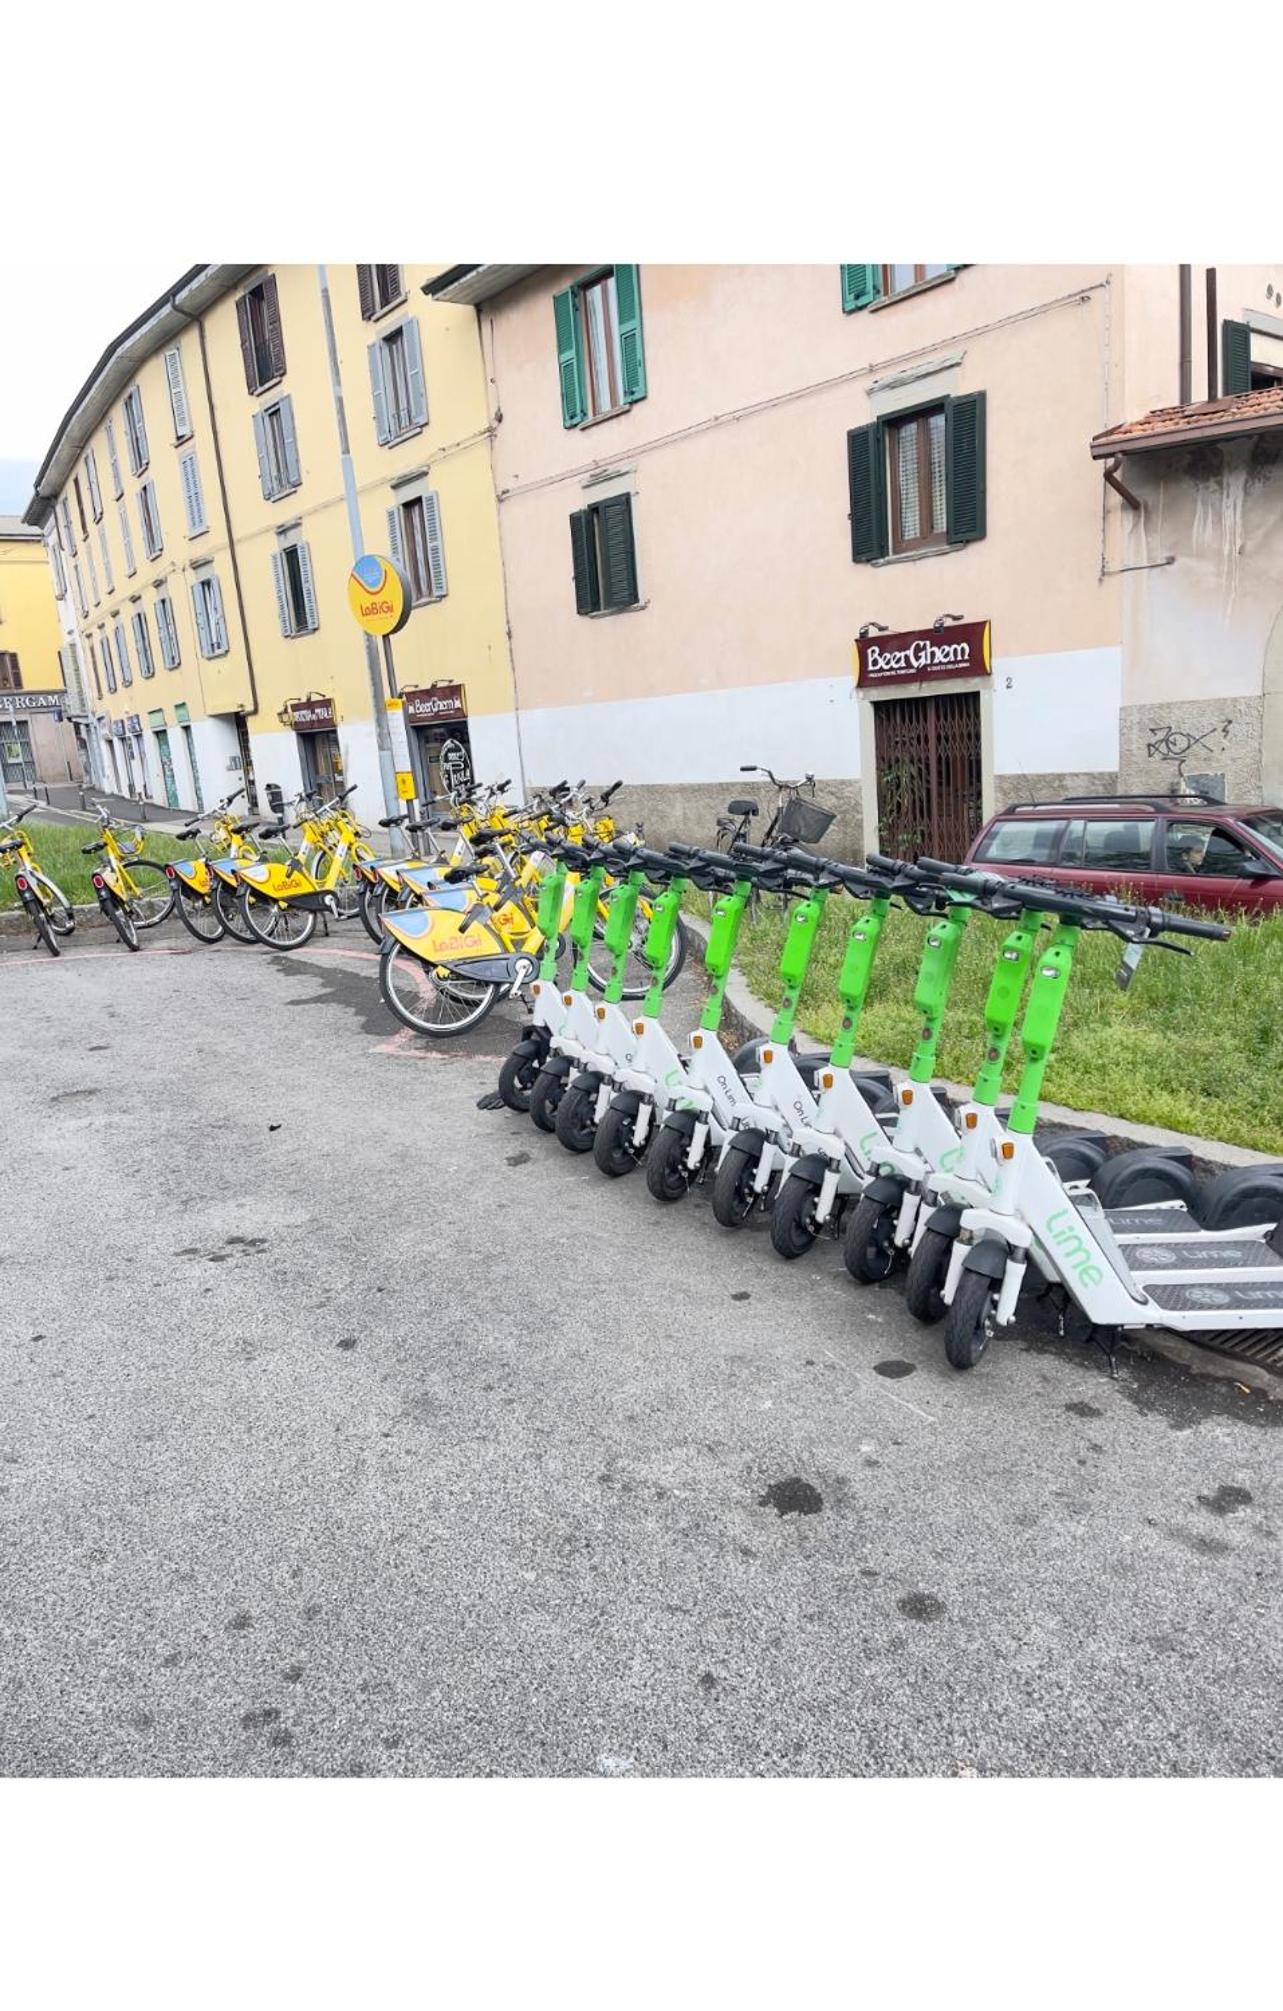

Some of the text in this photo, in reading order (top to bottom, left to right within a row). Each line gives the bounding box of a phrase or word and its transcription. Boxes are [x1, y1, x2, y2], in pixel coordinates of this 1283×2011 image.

[867, 640, 970, 671] BeerGhem
[1005, 677, 1013, 689] 2
[1045, 1209, 1104, 1289] Lime
[1183, 1249, 1243, 1260] Lime
[1233, 1289, 1283, 1300] Lim
